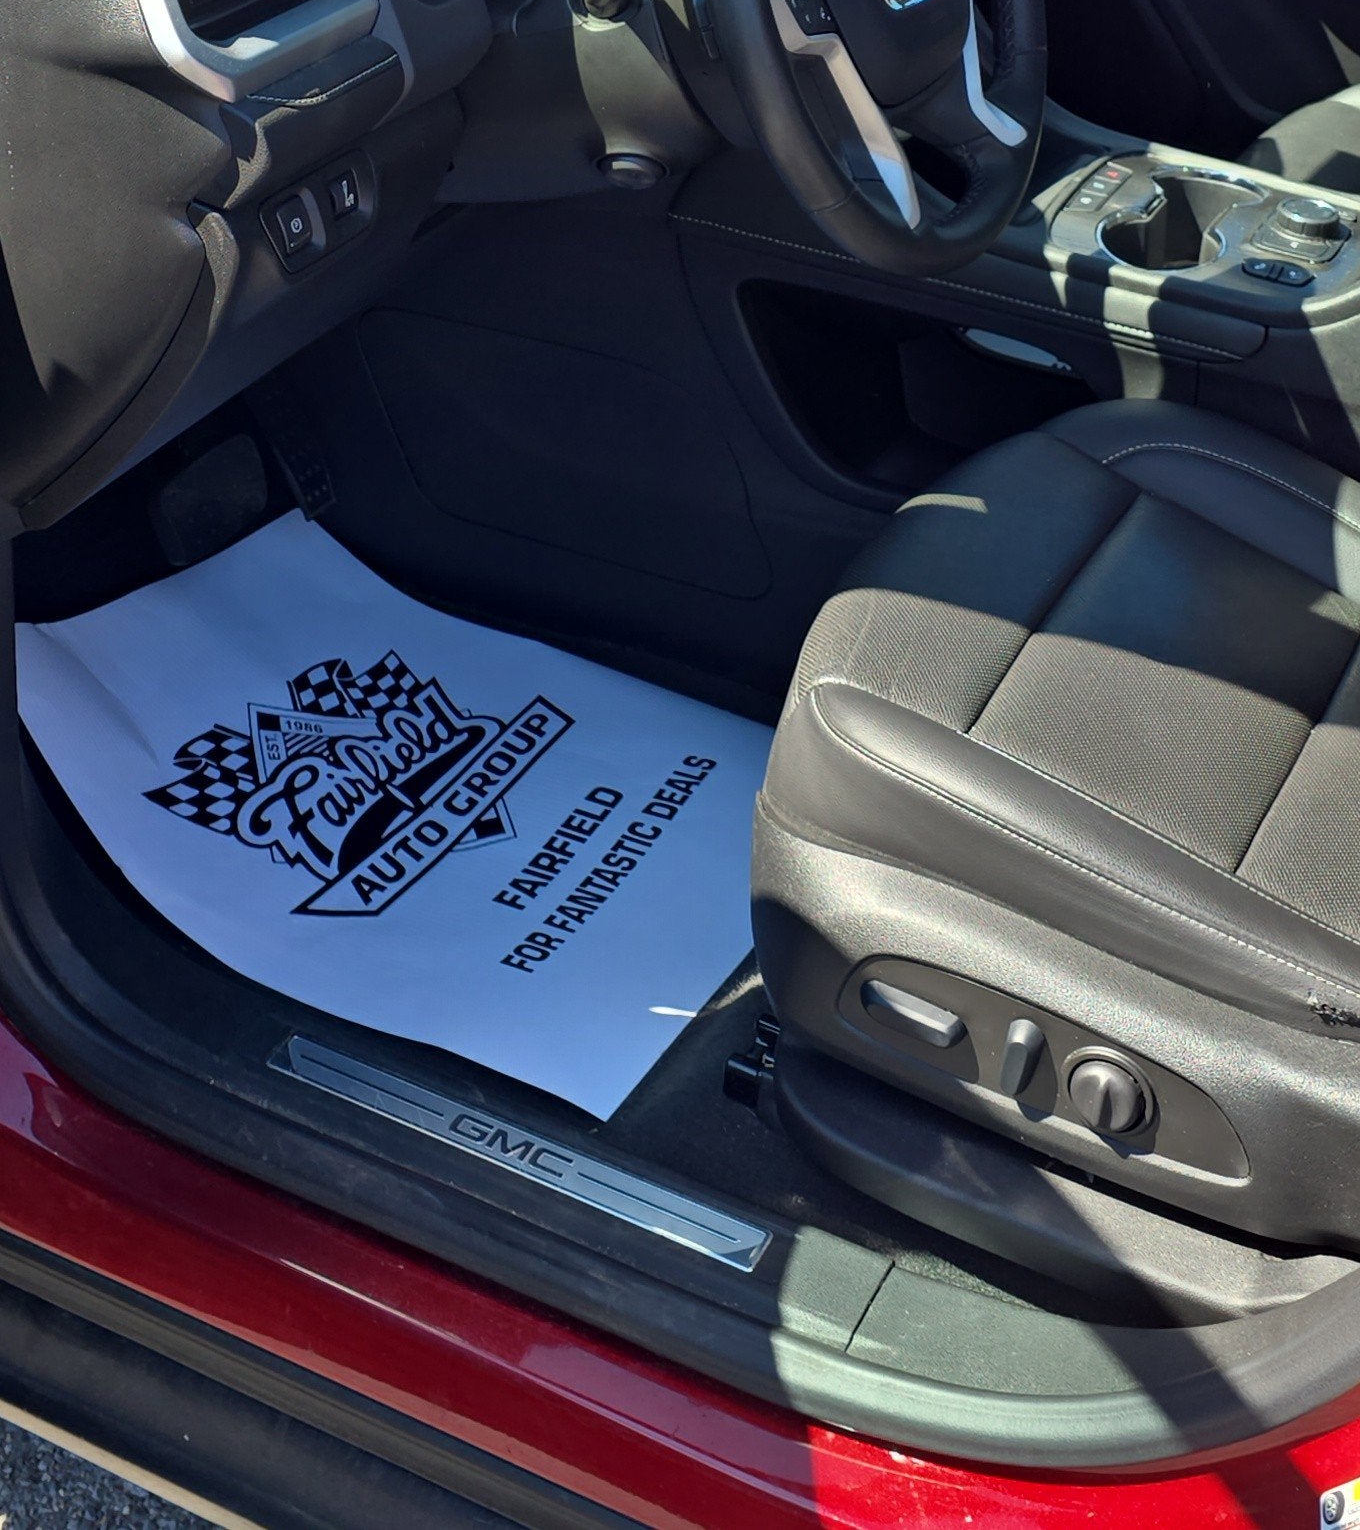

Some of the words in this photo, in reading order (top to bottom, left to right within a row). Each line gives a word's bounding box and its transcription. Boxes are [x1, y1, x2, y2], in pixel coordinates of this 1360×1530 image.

[248, 694, 486, 868] Fairfield
[285, 720, 324, 734] 1986
[351, 819, 449, 906] AUTO
[443, 713, 549, 817] GROUP
[492, 786, 625, 911] FAIRFIELD
[499, 931, 566, 974] FOR
[542, 821, 663, 934] FANTASTIC
[641, 755, 717, 821] DEALS
[449, 1113, 574, 1178] GMC
